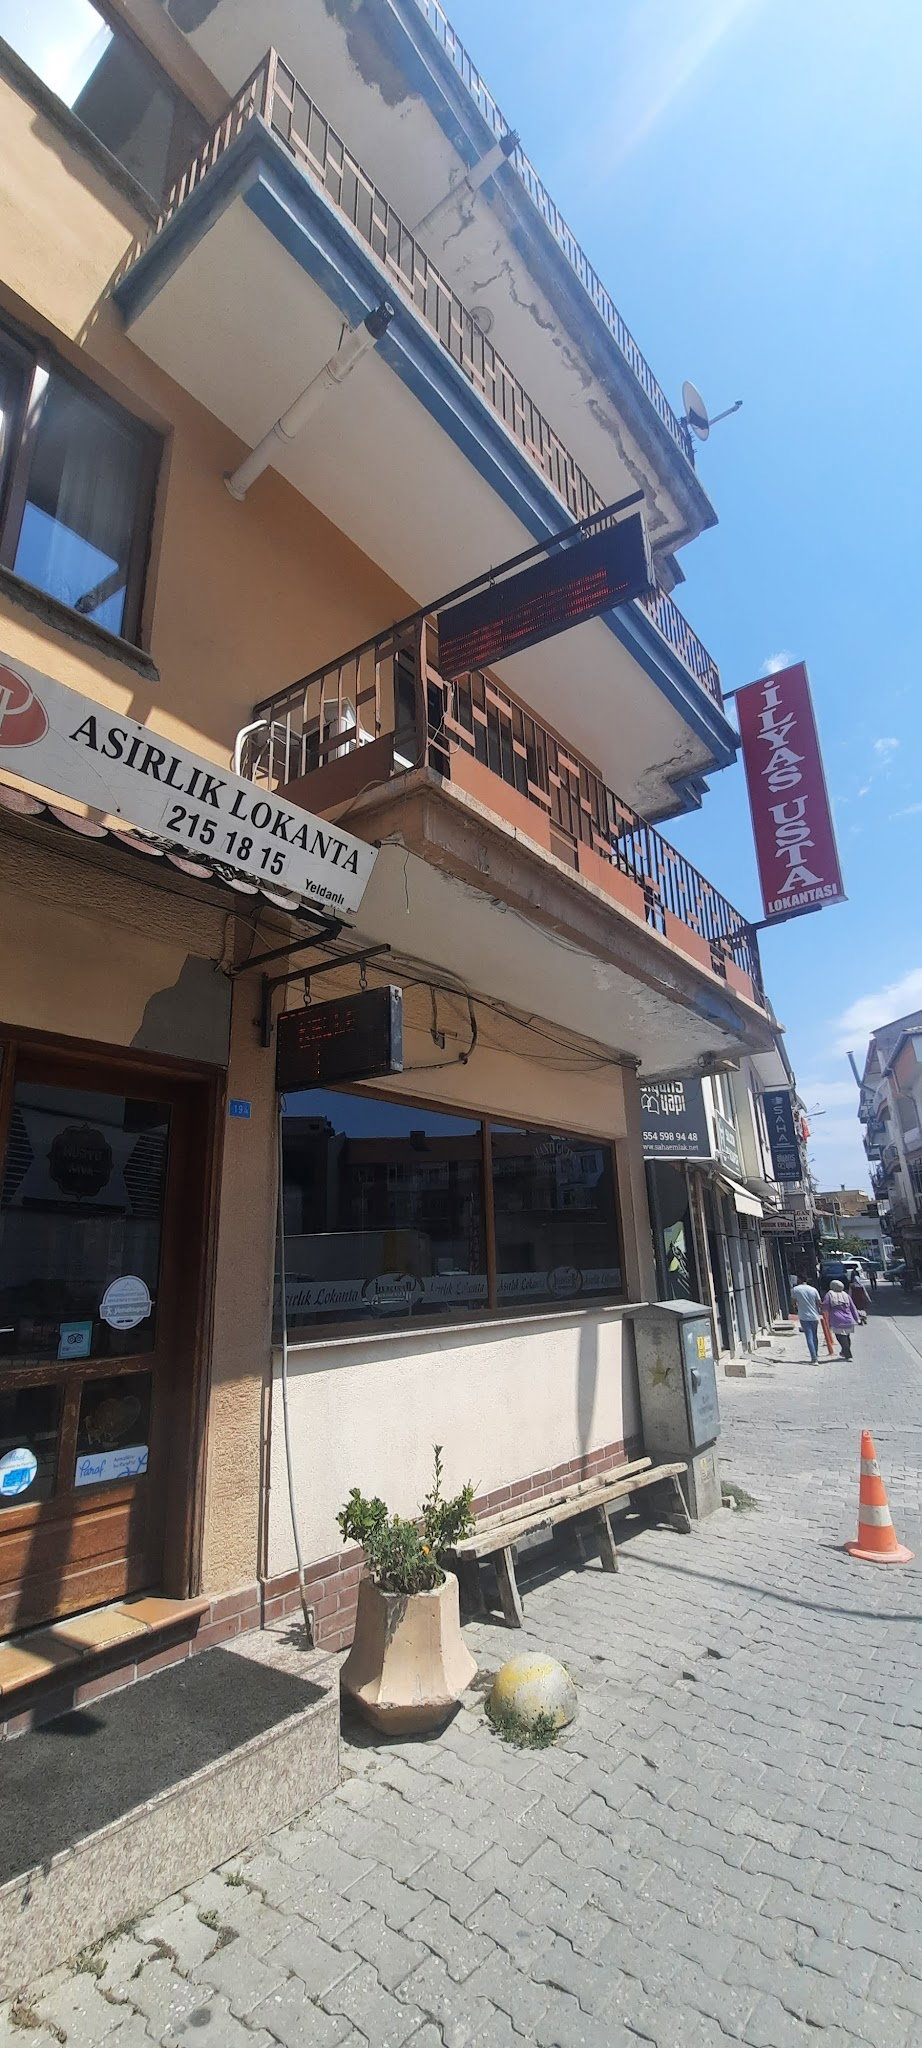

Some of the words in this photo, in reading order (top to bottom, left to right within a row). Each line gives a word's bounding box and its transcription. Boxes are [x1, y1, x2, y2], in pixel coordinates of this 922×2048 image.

[757, 680, 805, 793] İLYAS
[68, 714, 228, 809] ASIRLIK
[228, 788, 359, 875] LOKANTA
[166, 804, 219, 846] 215
[225, 831, 252, 862] 18
[260, 846, 287, 877] 15
[768, 794, 823, 894] USTA
[767, 882, 838, 914] LOKANTASI
[643, 1131, 658, 1141] 554
[659, 1132, 674, 1142] 598
[674, 1132, 687, 1142] 94
[688, 1132, 699, 1142] 48
[772, 1105, 788, 1143] SAHA
[313, 1288, 359, 1306] Lokanta
[79, 1459, 107, 1478] Paraf
